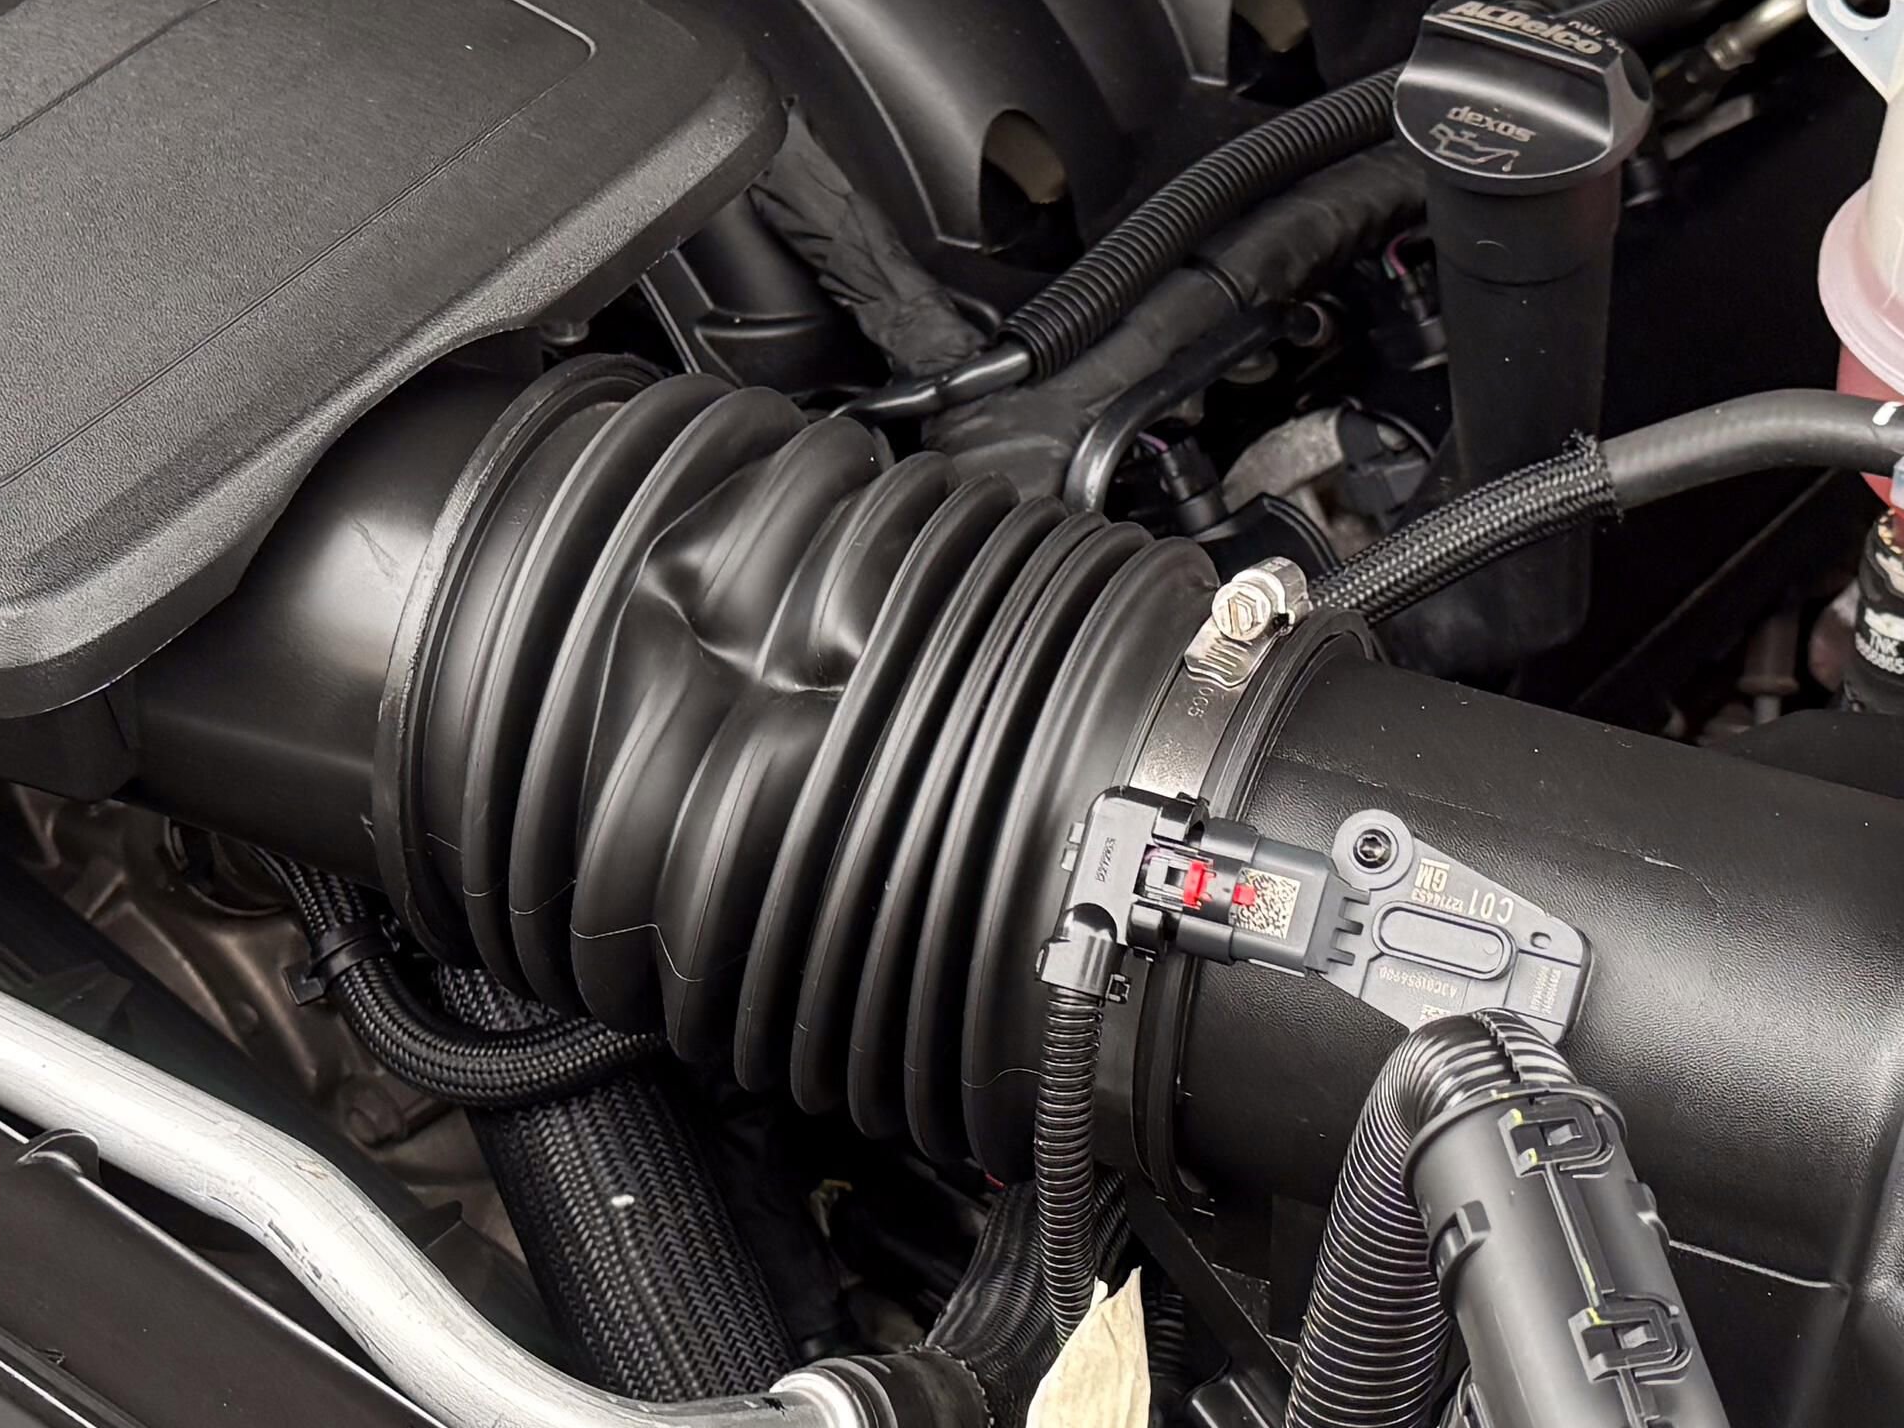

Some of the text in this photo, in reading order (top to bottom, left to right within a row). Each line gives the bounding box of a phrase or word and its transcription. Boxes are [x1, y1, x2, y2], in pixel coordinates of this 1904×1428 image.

[1448, 0, 1602, 55] ACDelco
[1446, 105, 1537, 143] dexos
[1414, 860, 1449, 891] GM
[1468, 888, 1515, 924] C01
